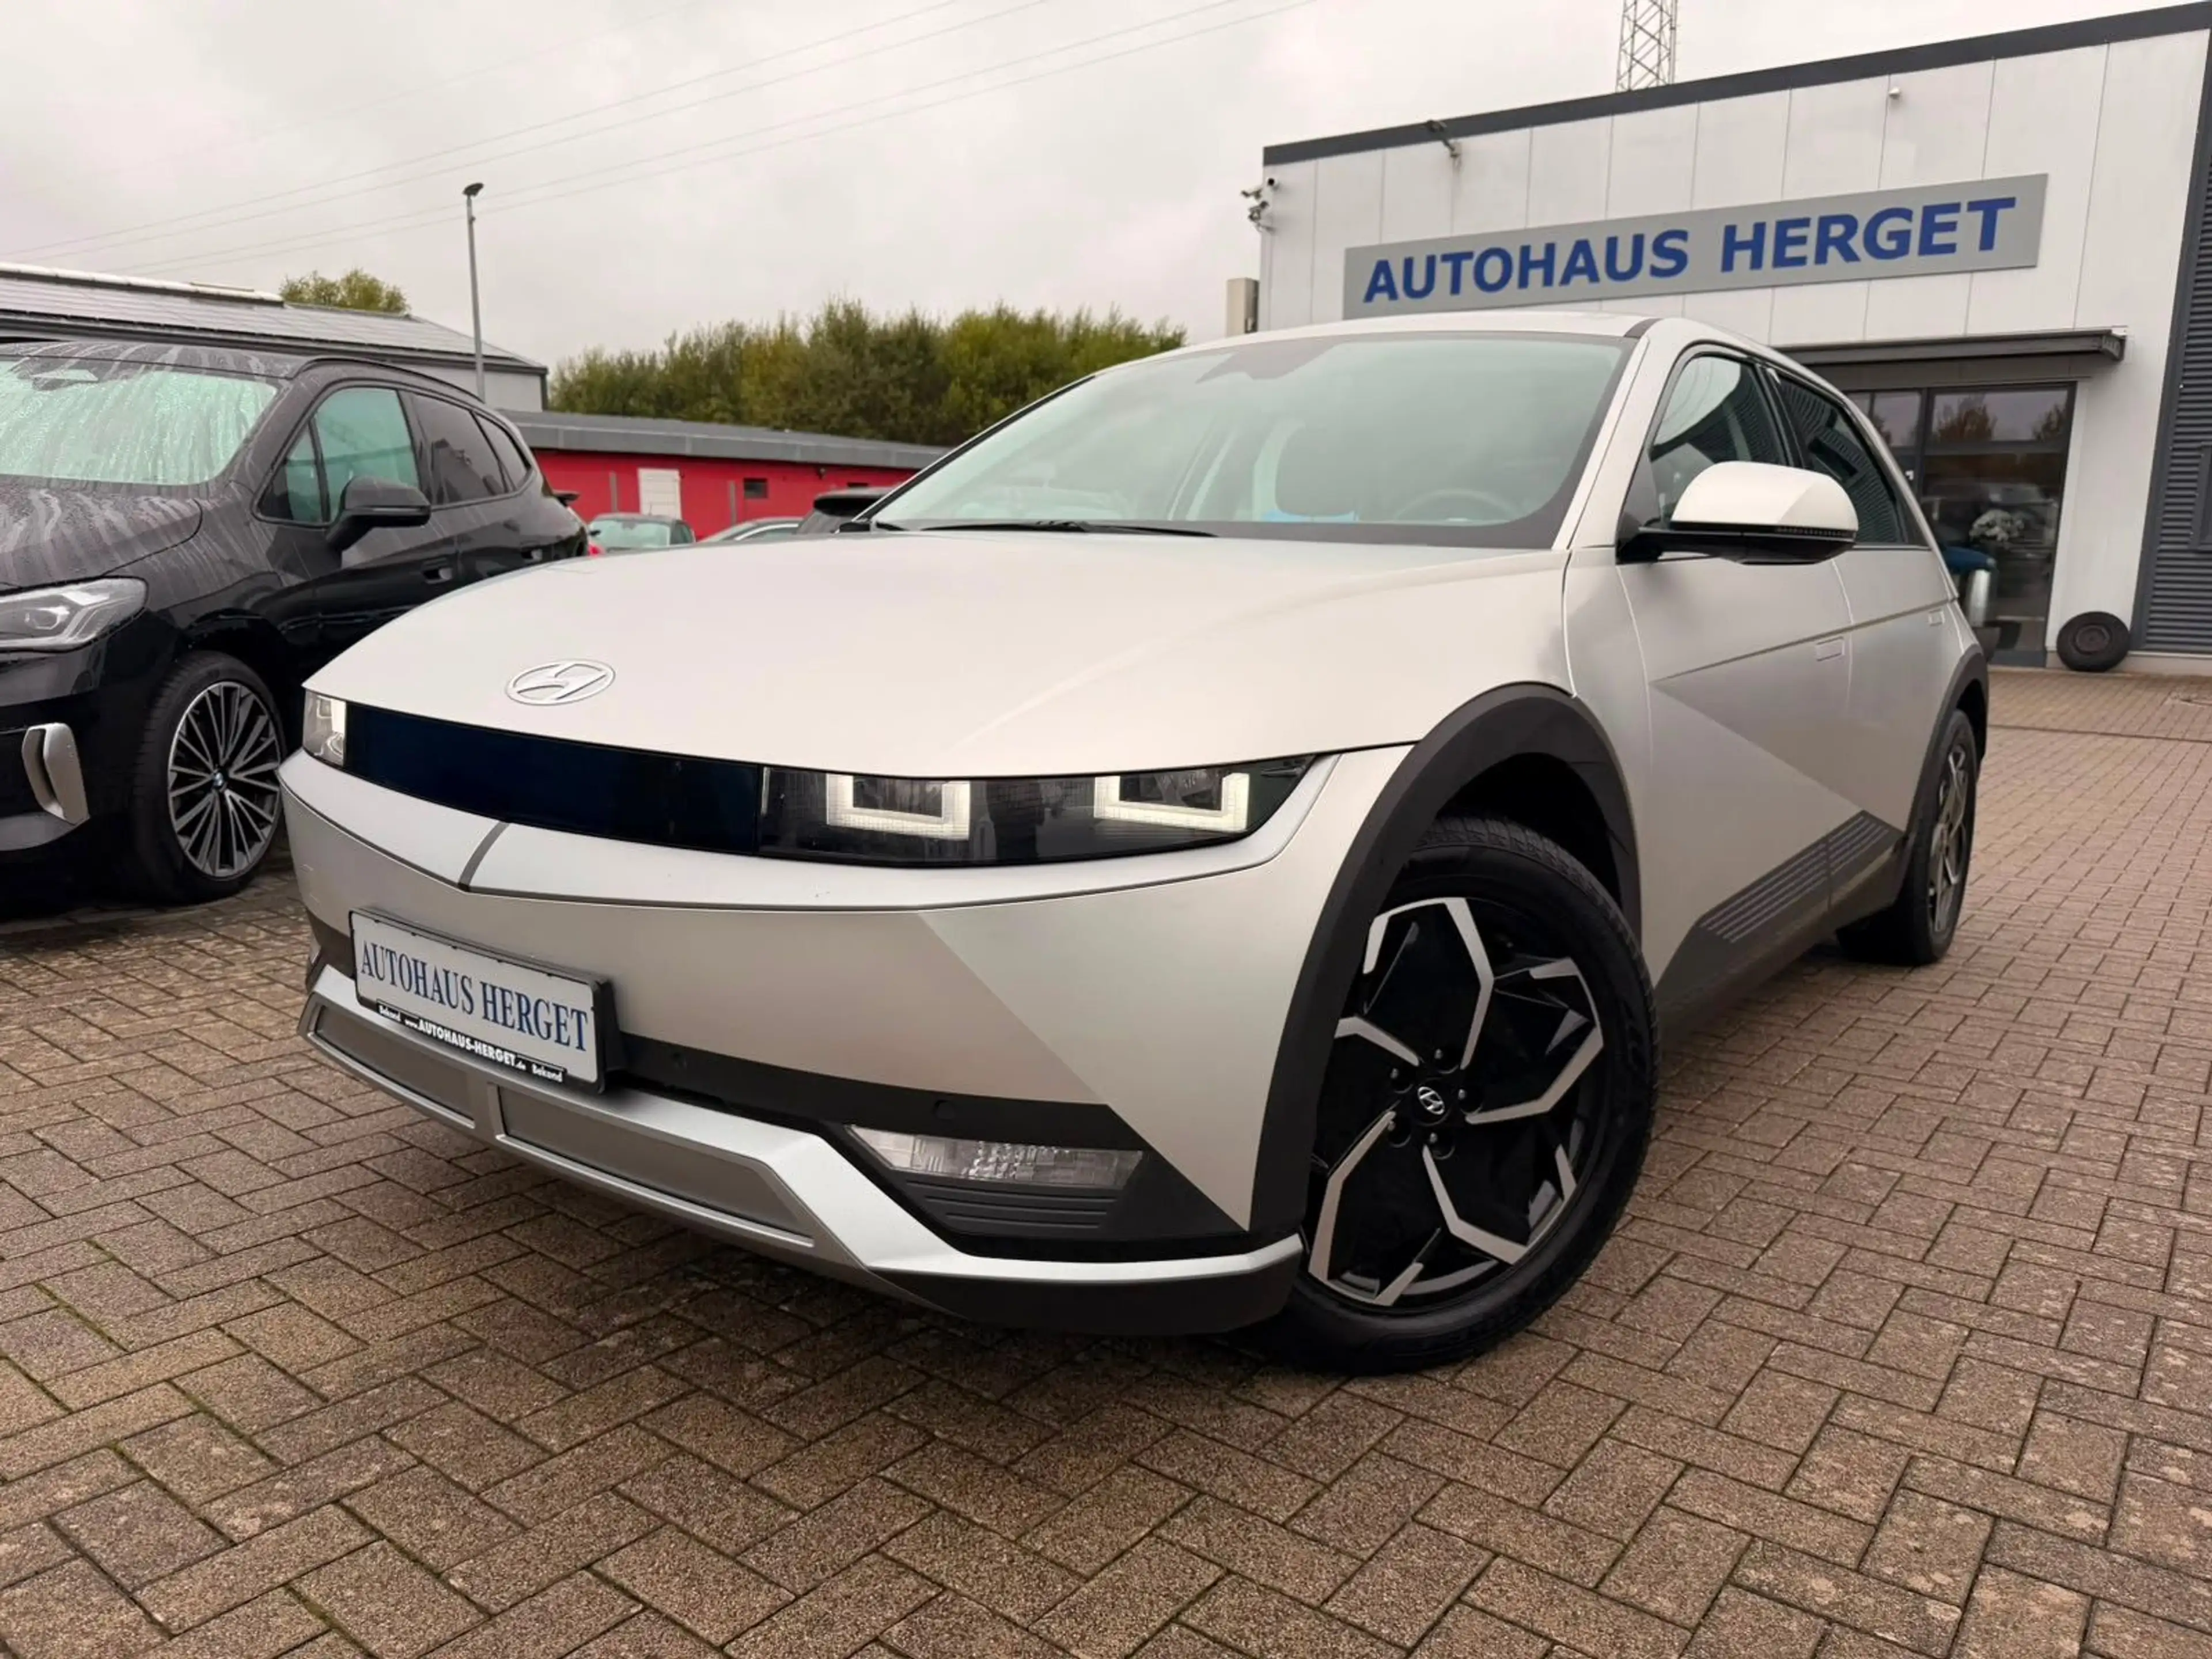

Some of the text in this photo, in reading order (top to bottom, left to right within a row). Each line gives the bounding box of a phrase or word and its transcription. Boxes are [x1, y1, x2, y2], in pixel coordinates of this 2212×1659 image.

[1363, 197, 2016, 303] AUTOHAUS HERGET
[361, 941, 588, 1052] AUTOHAUS HERGET
